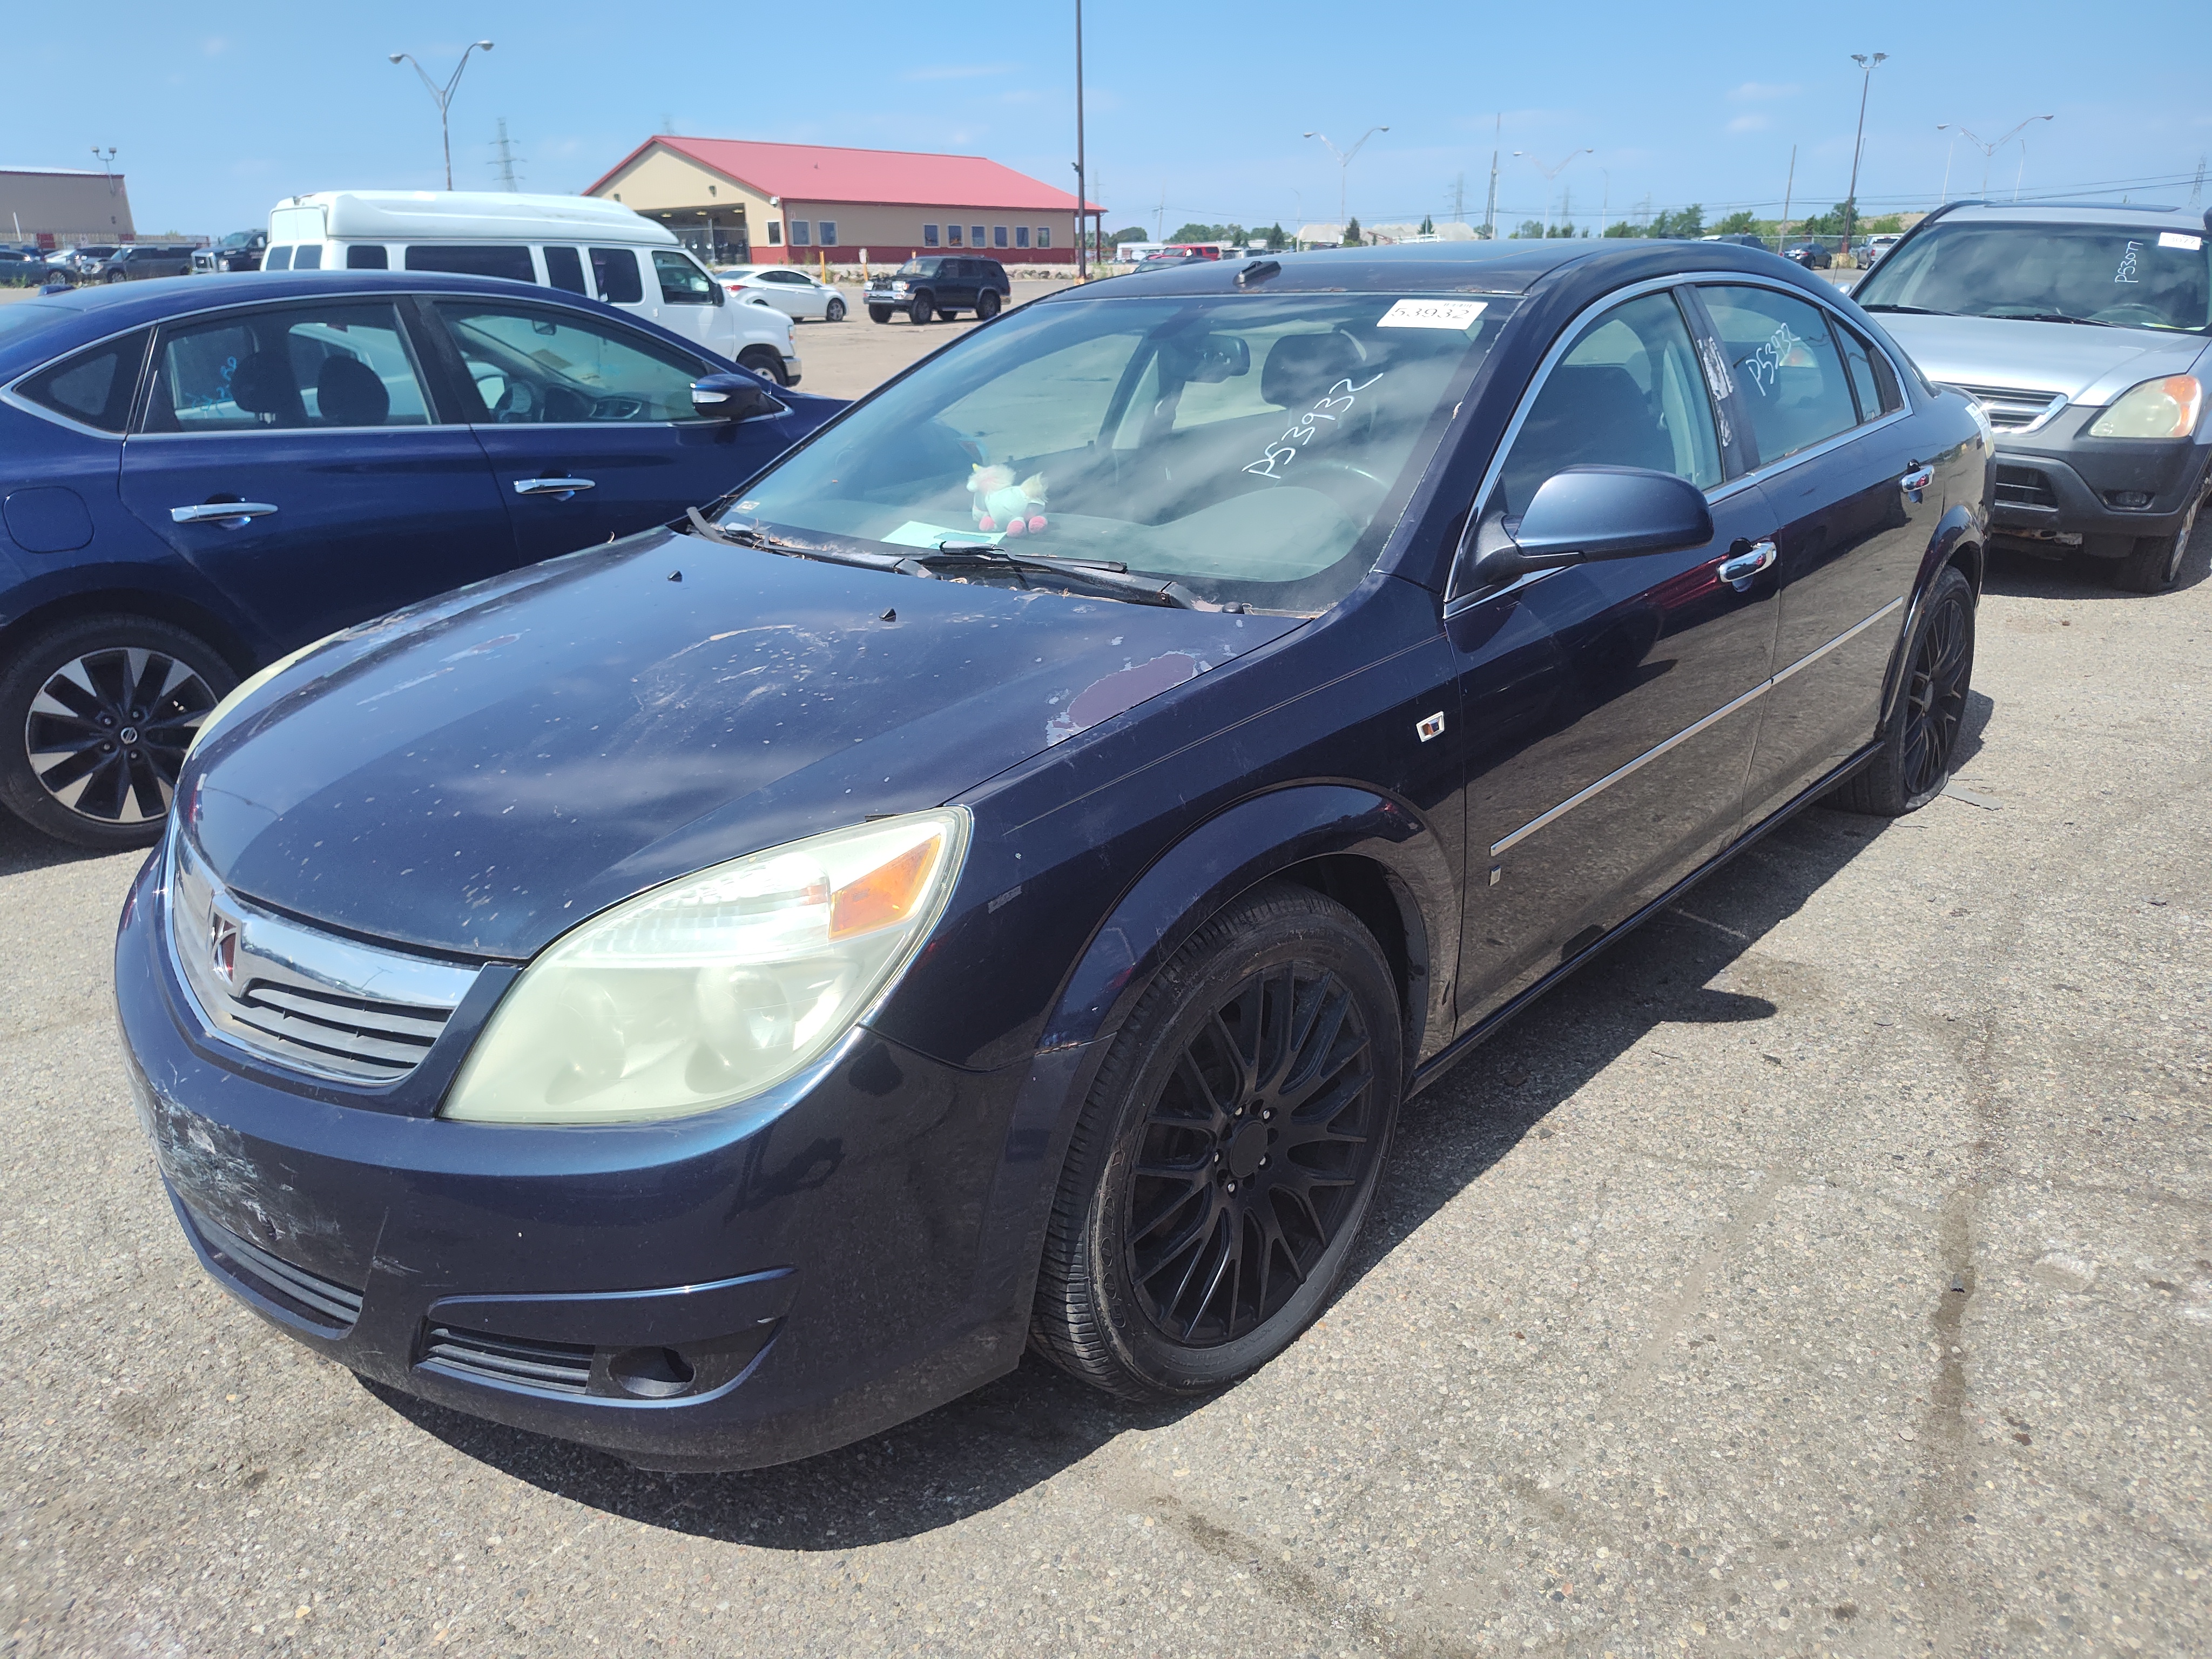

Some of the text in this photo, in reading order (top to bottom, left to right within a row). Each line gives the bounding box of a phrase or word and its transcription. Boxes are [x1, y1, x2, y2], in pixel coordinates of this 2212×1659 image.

[2114, 241, 2144, 283] P53077
[1745, 322, 1801, 397] P53932
[1242, 372, 1385, 480] P53932
